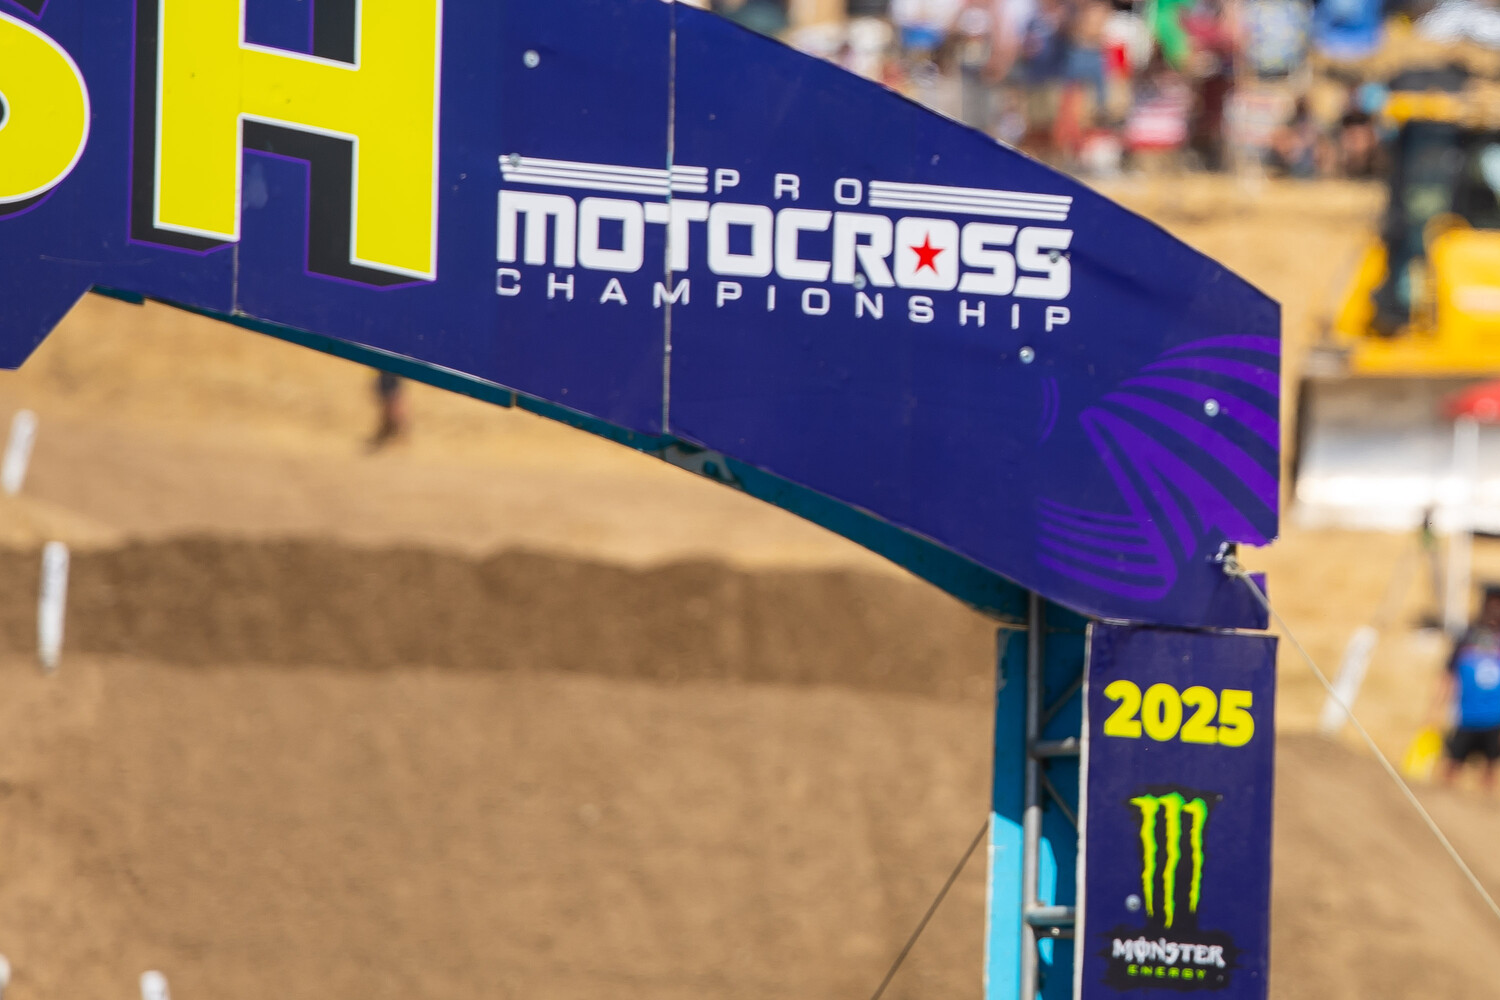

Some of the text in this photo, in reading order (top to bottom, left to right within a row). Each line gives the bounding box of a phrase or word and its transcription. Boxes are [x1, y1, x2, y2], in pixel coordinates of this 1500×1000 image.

[714, 167, 864, 206] PRO
[496, 188, 1074, 301] MOTOCROSS
[496, 267, 1072, 333] CHAMPIONSHIP
[1103, 680, 1255, 747] 2025
[1112, 936, 1226, 968] MONSTER
[1127, 964, 1206, 980] ENERGY
